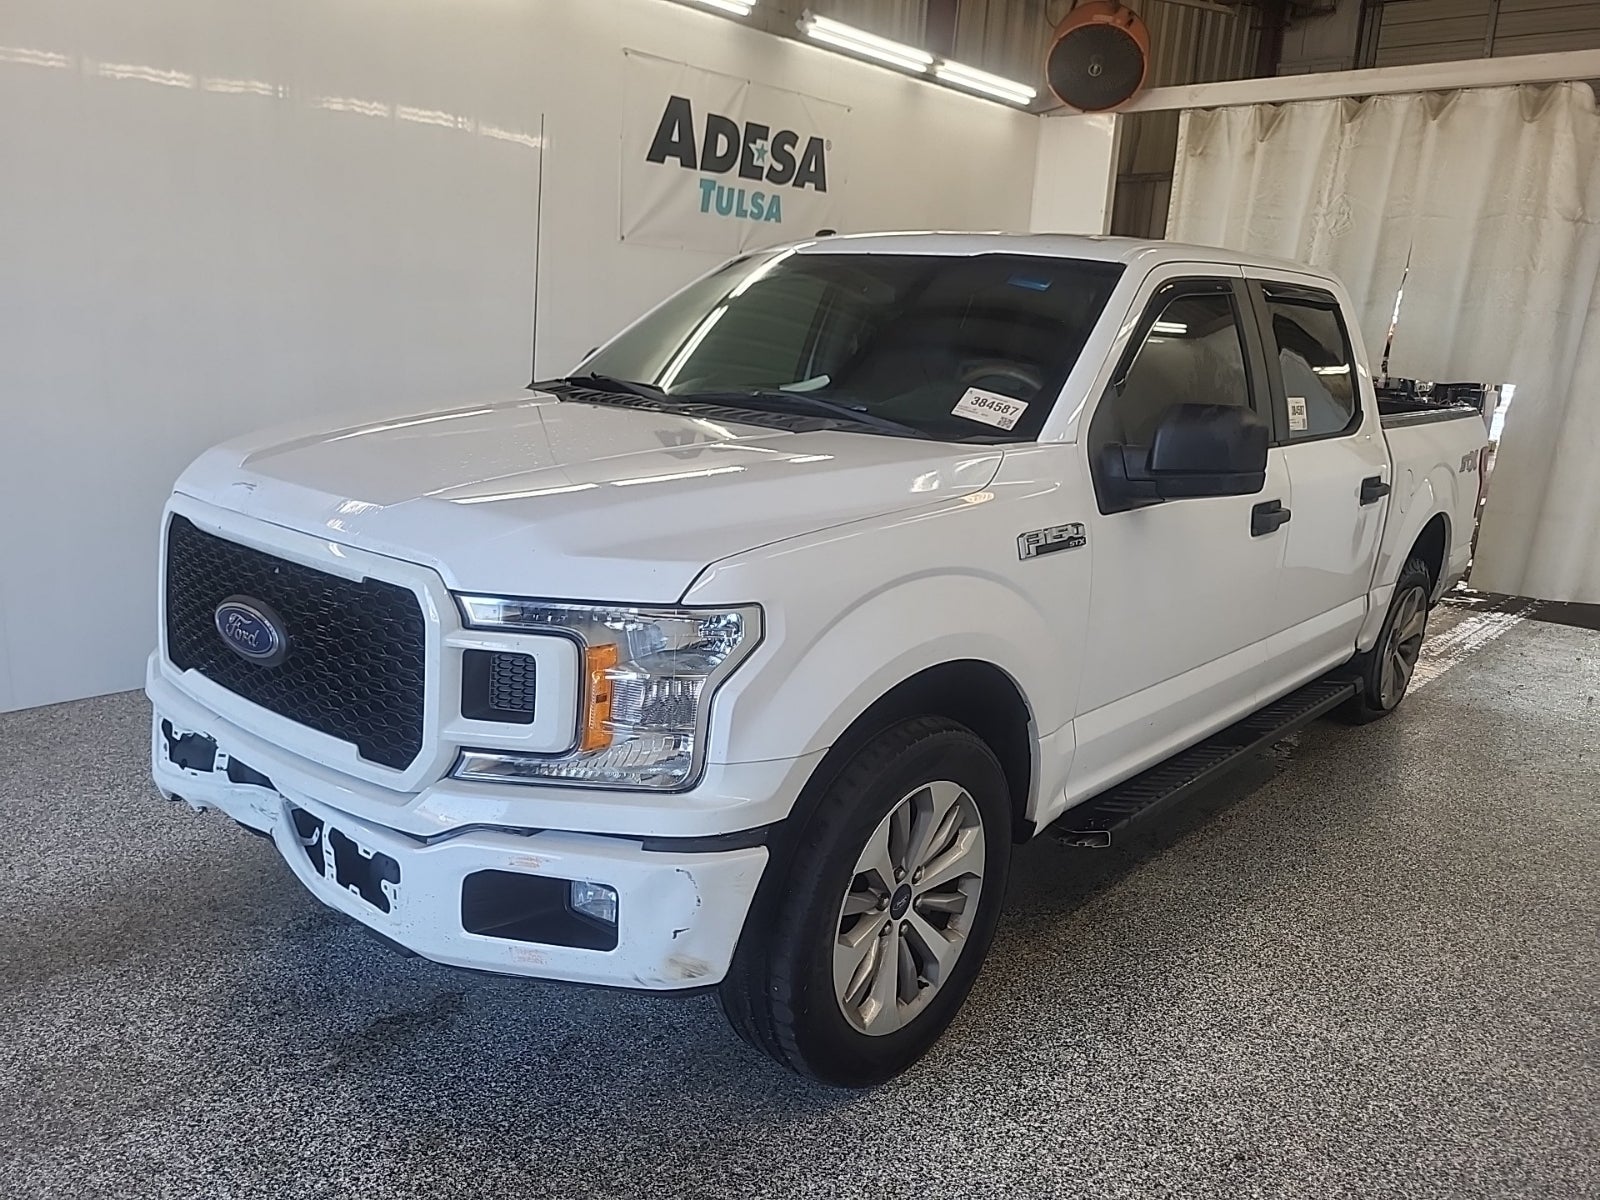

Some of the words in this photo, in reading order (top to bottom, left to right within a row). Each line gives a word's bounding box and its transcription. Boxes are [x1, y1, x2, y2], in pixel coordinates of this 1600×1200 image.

[699, 178, 782, 223] TULSA
[970, 396, 1019, 416] 384587
[226, 612, 260, 648] Ford
